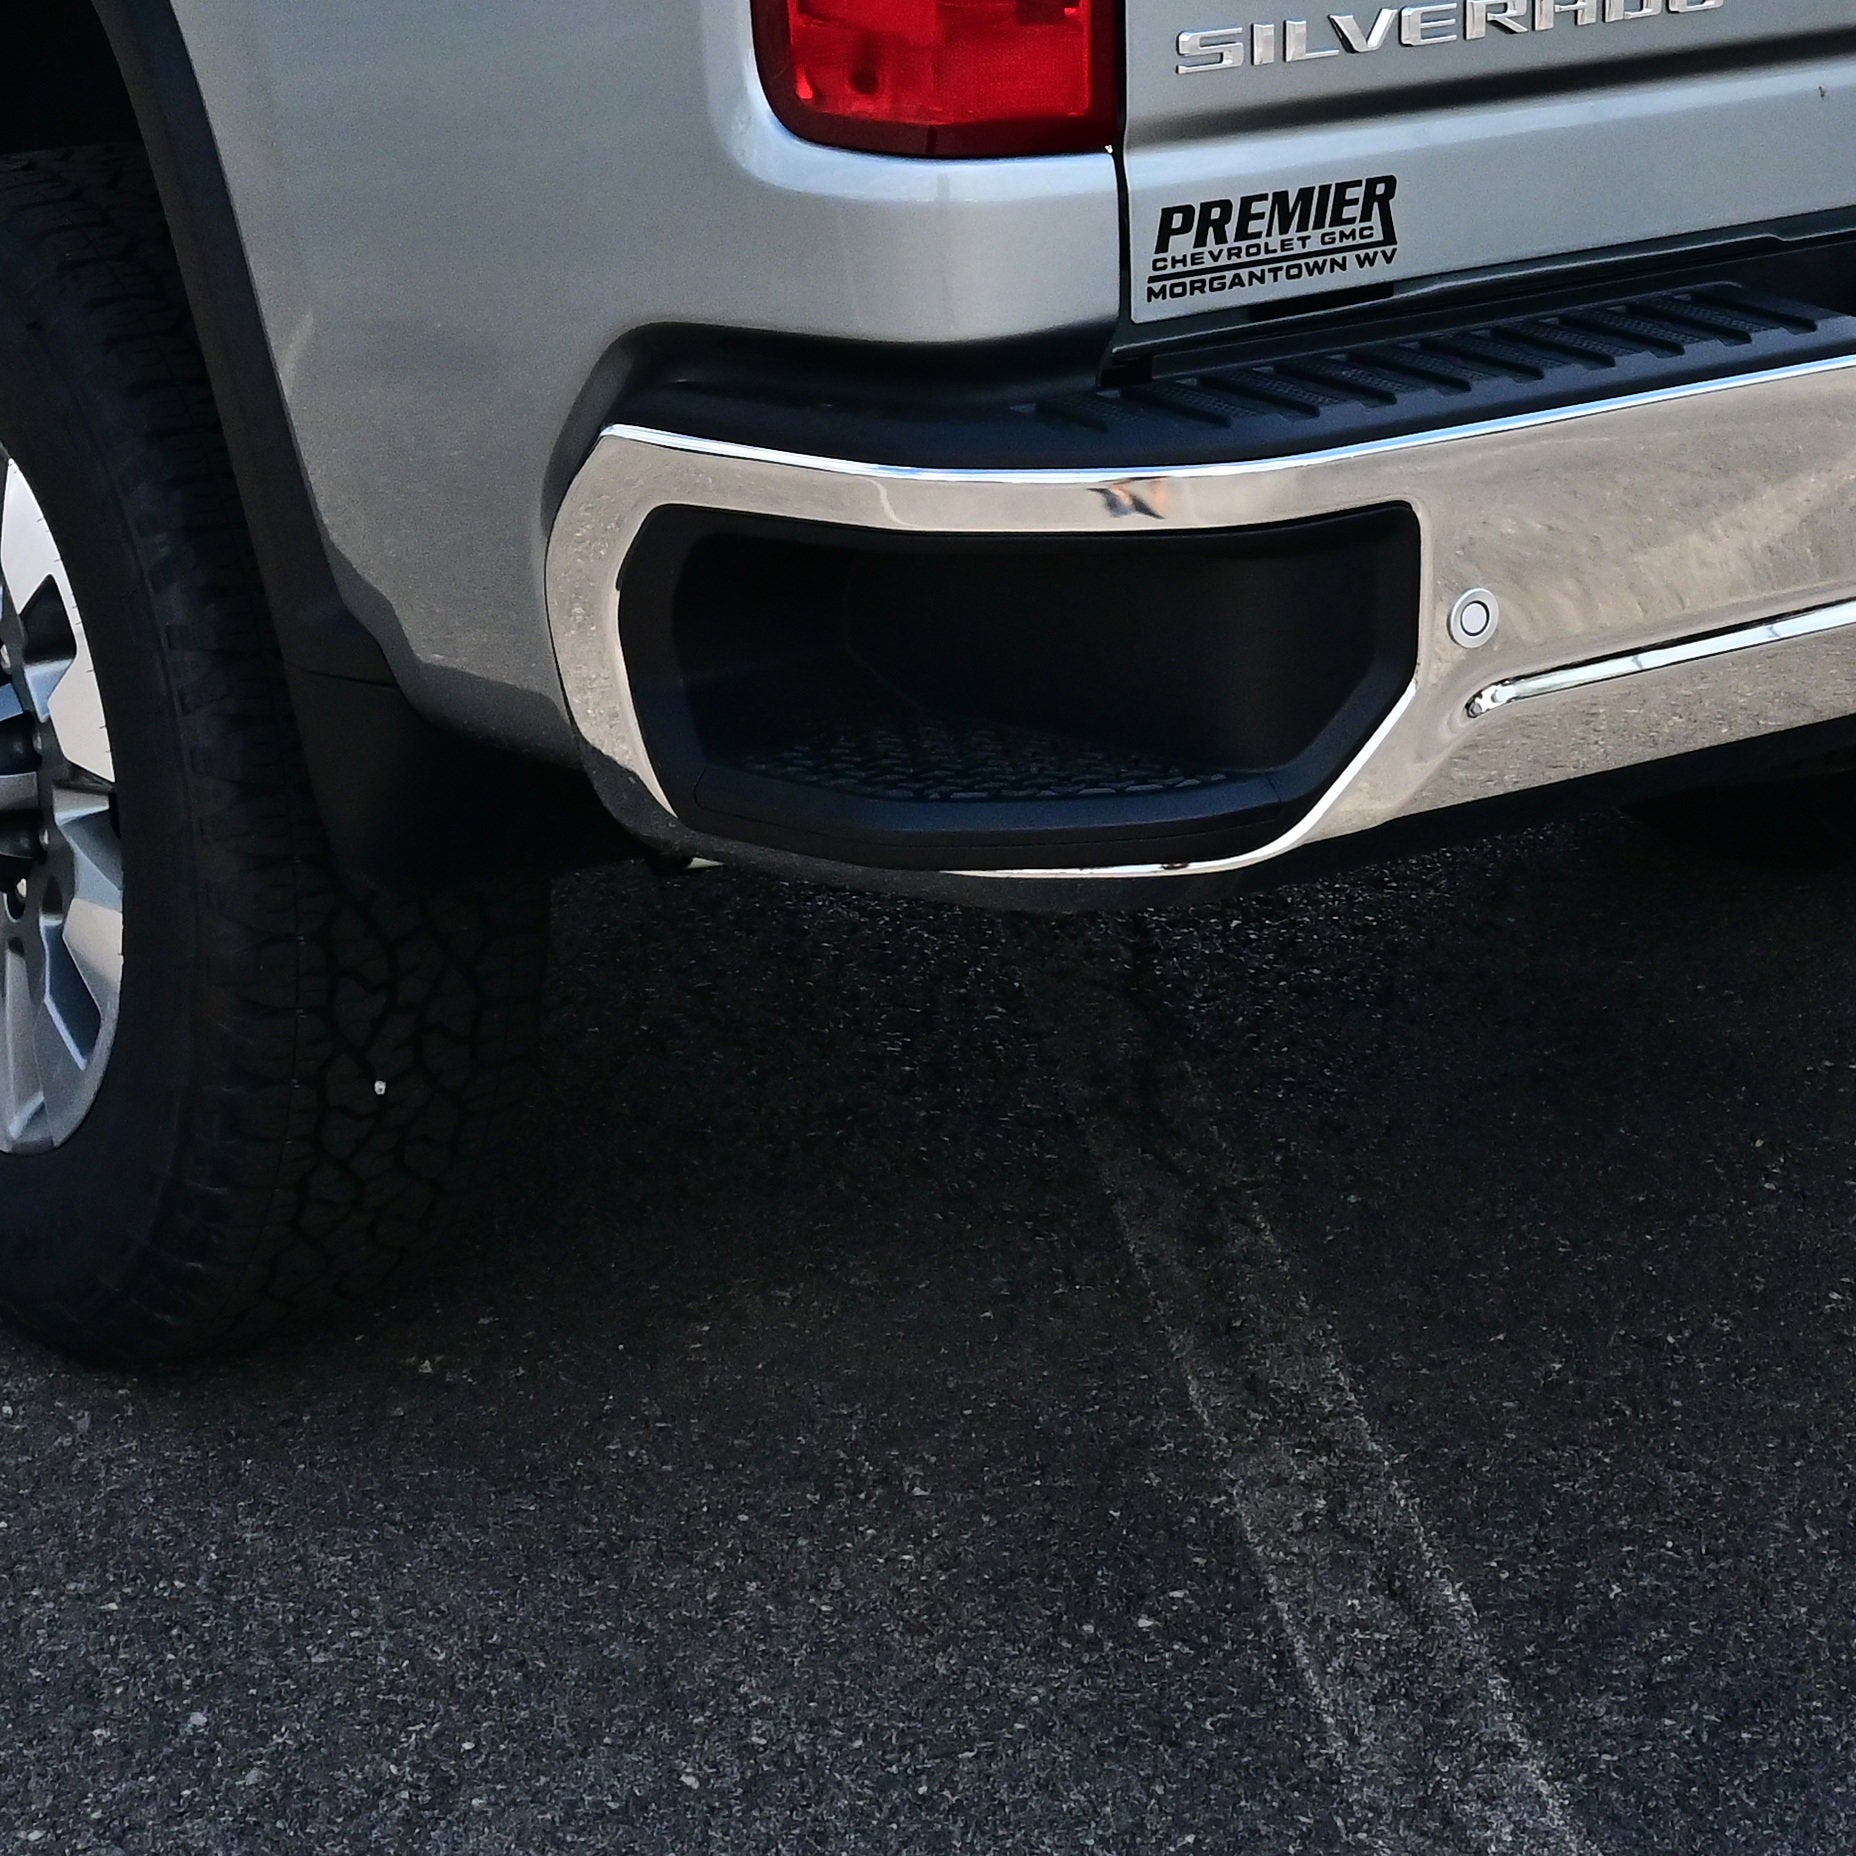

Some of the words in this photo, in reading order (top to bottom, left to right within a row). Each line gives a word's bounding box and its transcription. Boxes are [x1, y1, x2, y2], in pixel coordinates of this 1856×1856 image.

[1154, 174, 1399, 255] PREMIER
[1146, 256, 1348, 303] MORGANTOWN
[1355, 247, 1399, 270] WV
[1151, 234, 1312, 272] CHEVROLET
[1320, 225, 1375, 246] GMC
